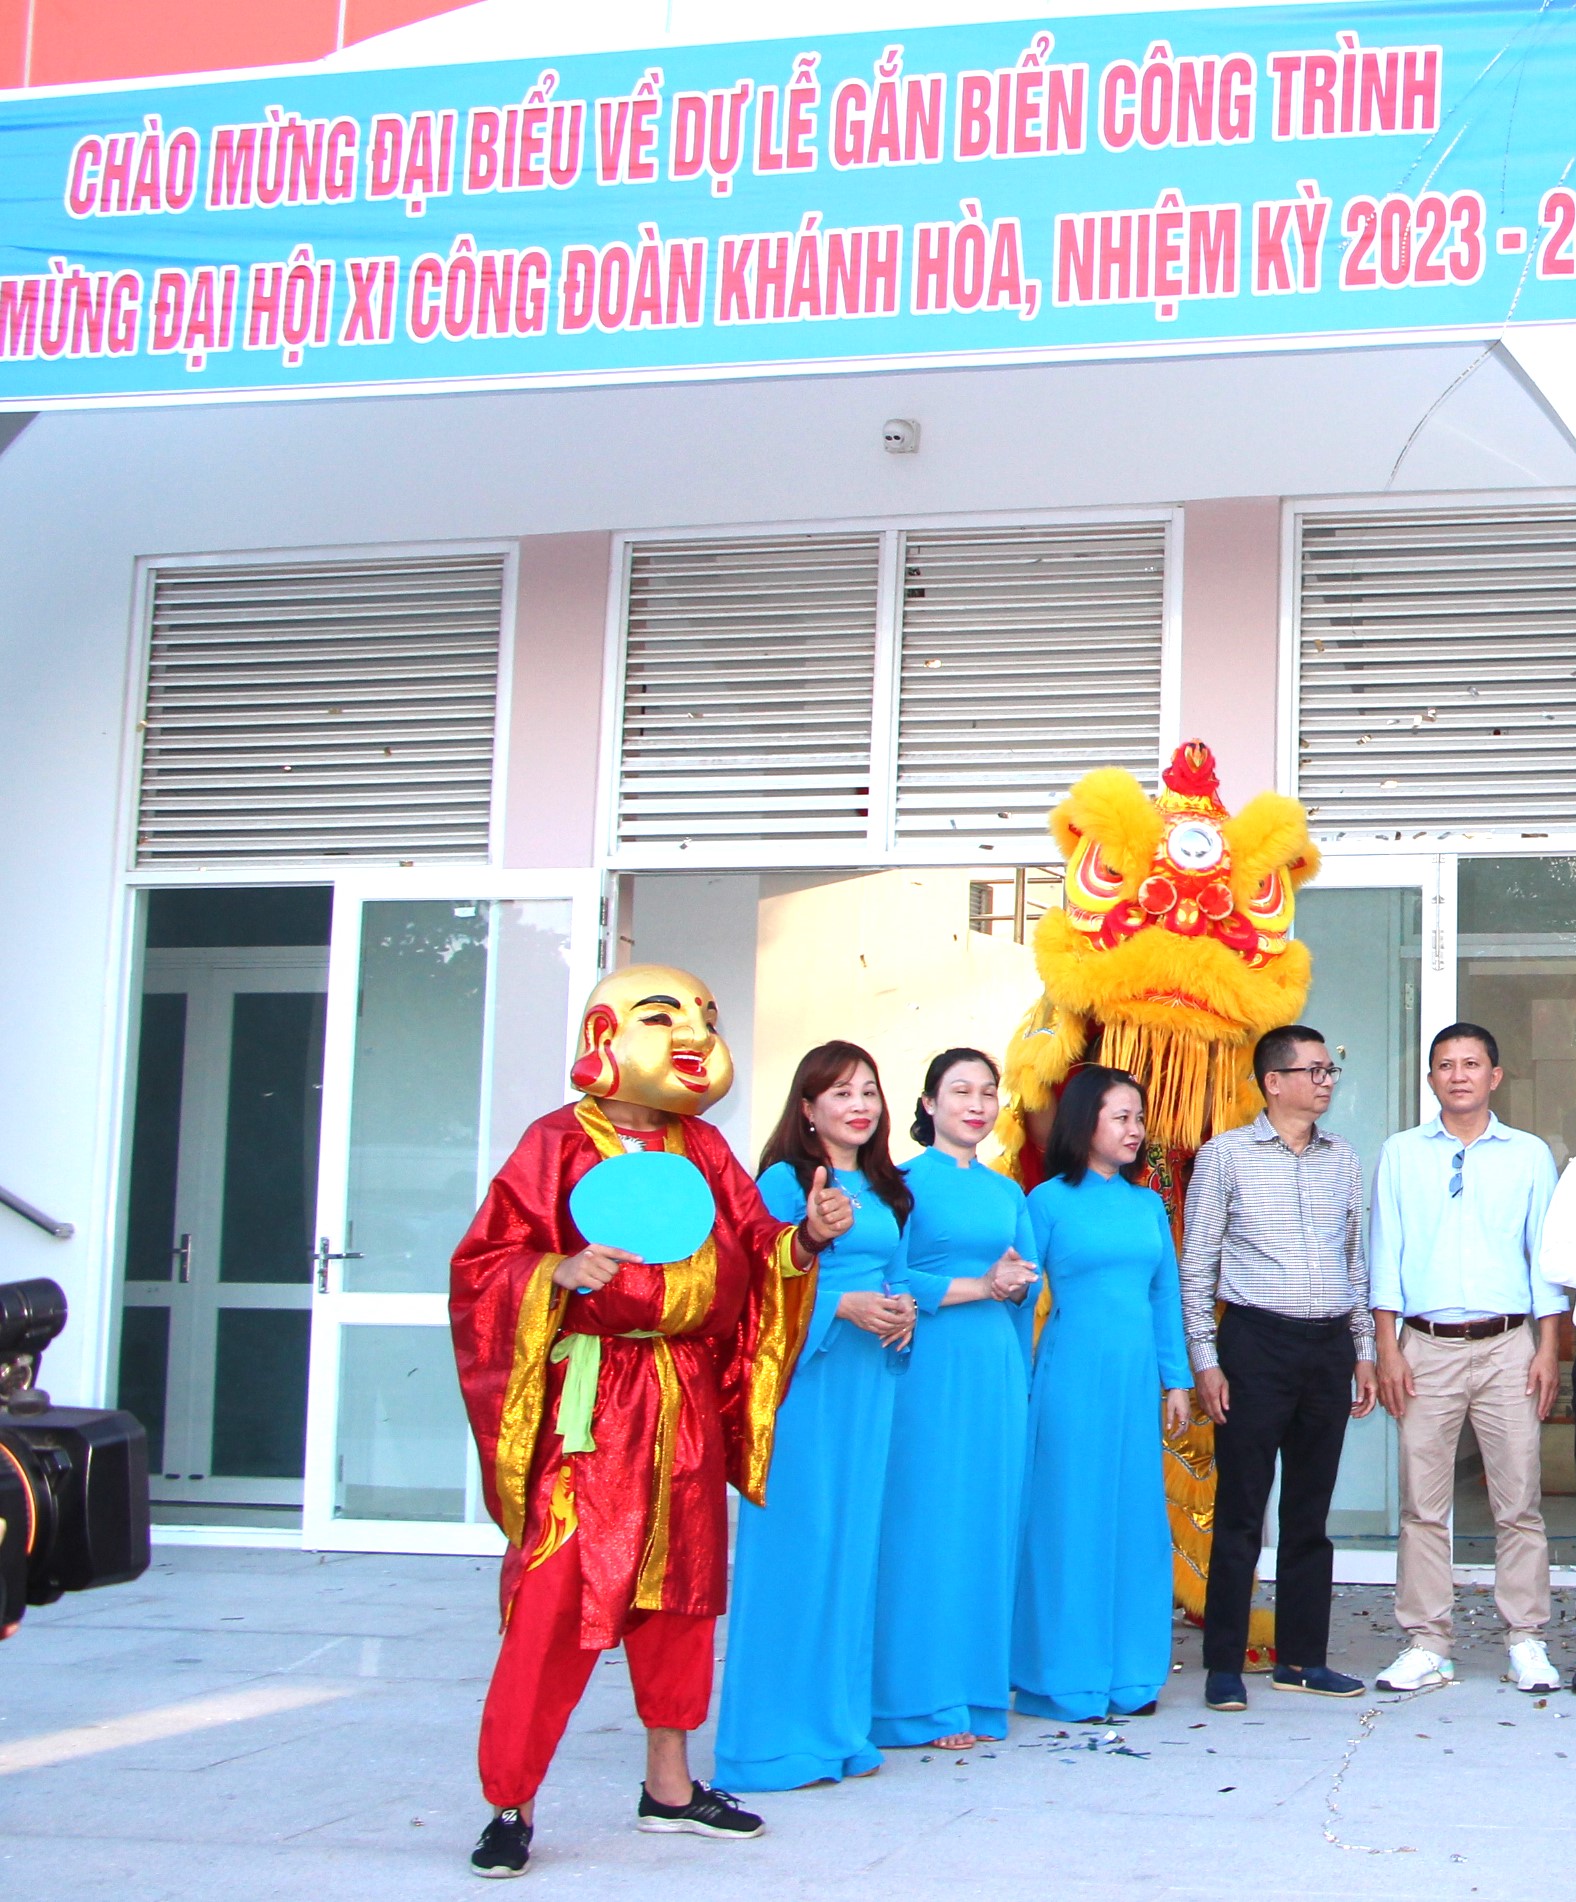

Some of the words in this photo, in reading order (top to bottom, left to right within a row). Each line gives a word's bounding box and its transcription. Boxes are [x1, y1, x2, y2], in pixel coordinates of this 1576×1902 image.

[70, 123, 194, 215] CHÀO
[211, 110, 354, 206] MỪNG
[372, 114, 453, 213] ĐẠI
[469, 72, 581, 190] BIỂU
[601, 72, 658, 180] VỀ
[674, 85, 748, 194] DỰ
[759, 57, 816, 171] LỄ
[835, 49, 942, 165] GẮN
[960, 36, 1084, 157] BIỂN
[1104, 45, 1252, 148] CÔNG
[1273, 35, 1438, 136] TRÌNH
[0, 262, 139, 356] MỪNG
[154, 270, 233, 367] ĐẠI
[250, 248, 330, 364] HỘI
[345, 261, 394, 341] XI
[411, 239, 546, 338] CÔNG
[564, 226, 703, 330] ĐOÀN
[720, 216, 898, 320] KHÁNH
[917, 204, 1037, 313] HÒA,
[1059, 194, 1236, 316] NHIỆM
[1258, 182, 1331, 290] KỲ
[1346, 195, 1480, 286] 2023
[1503, 233, 1521, 249] -
